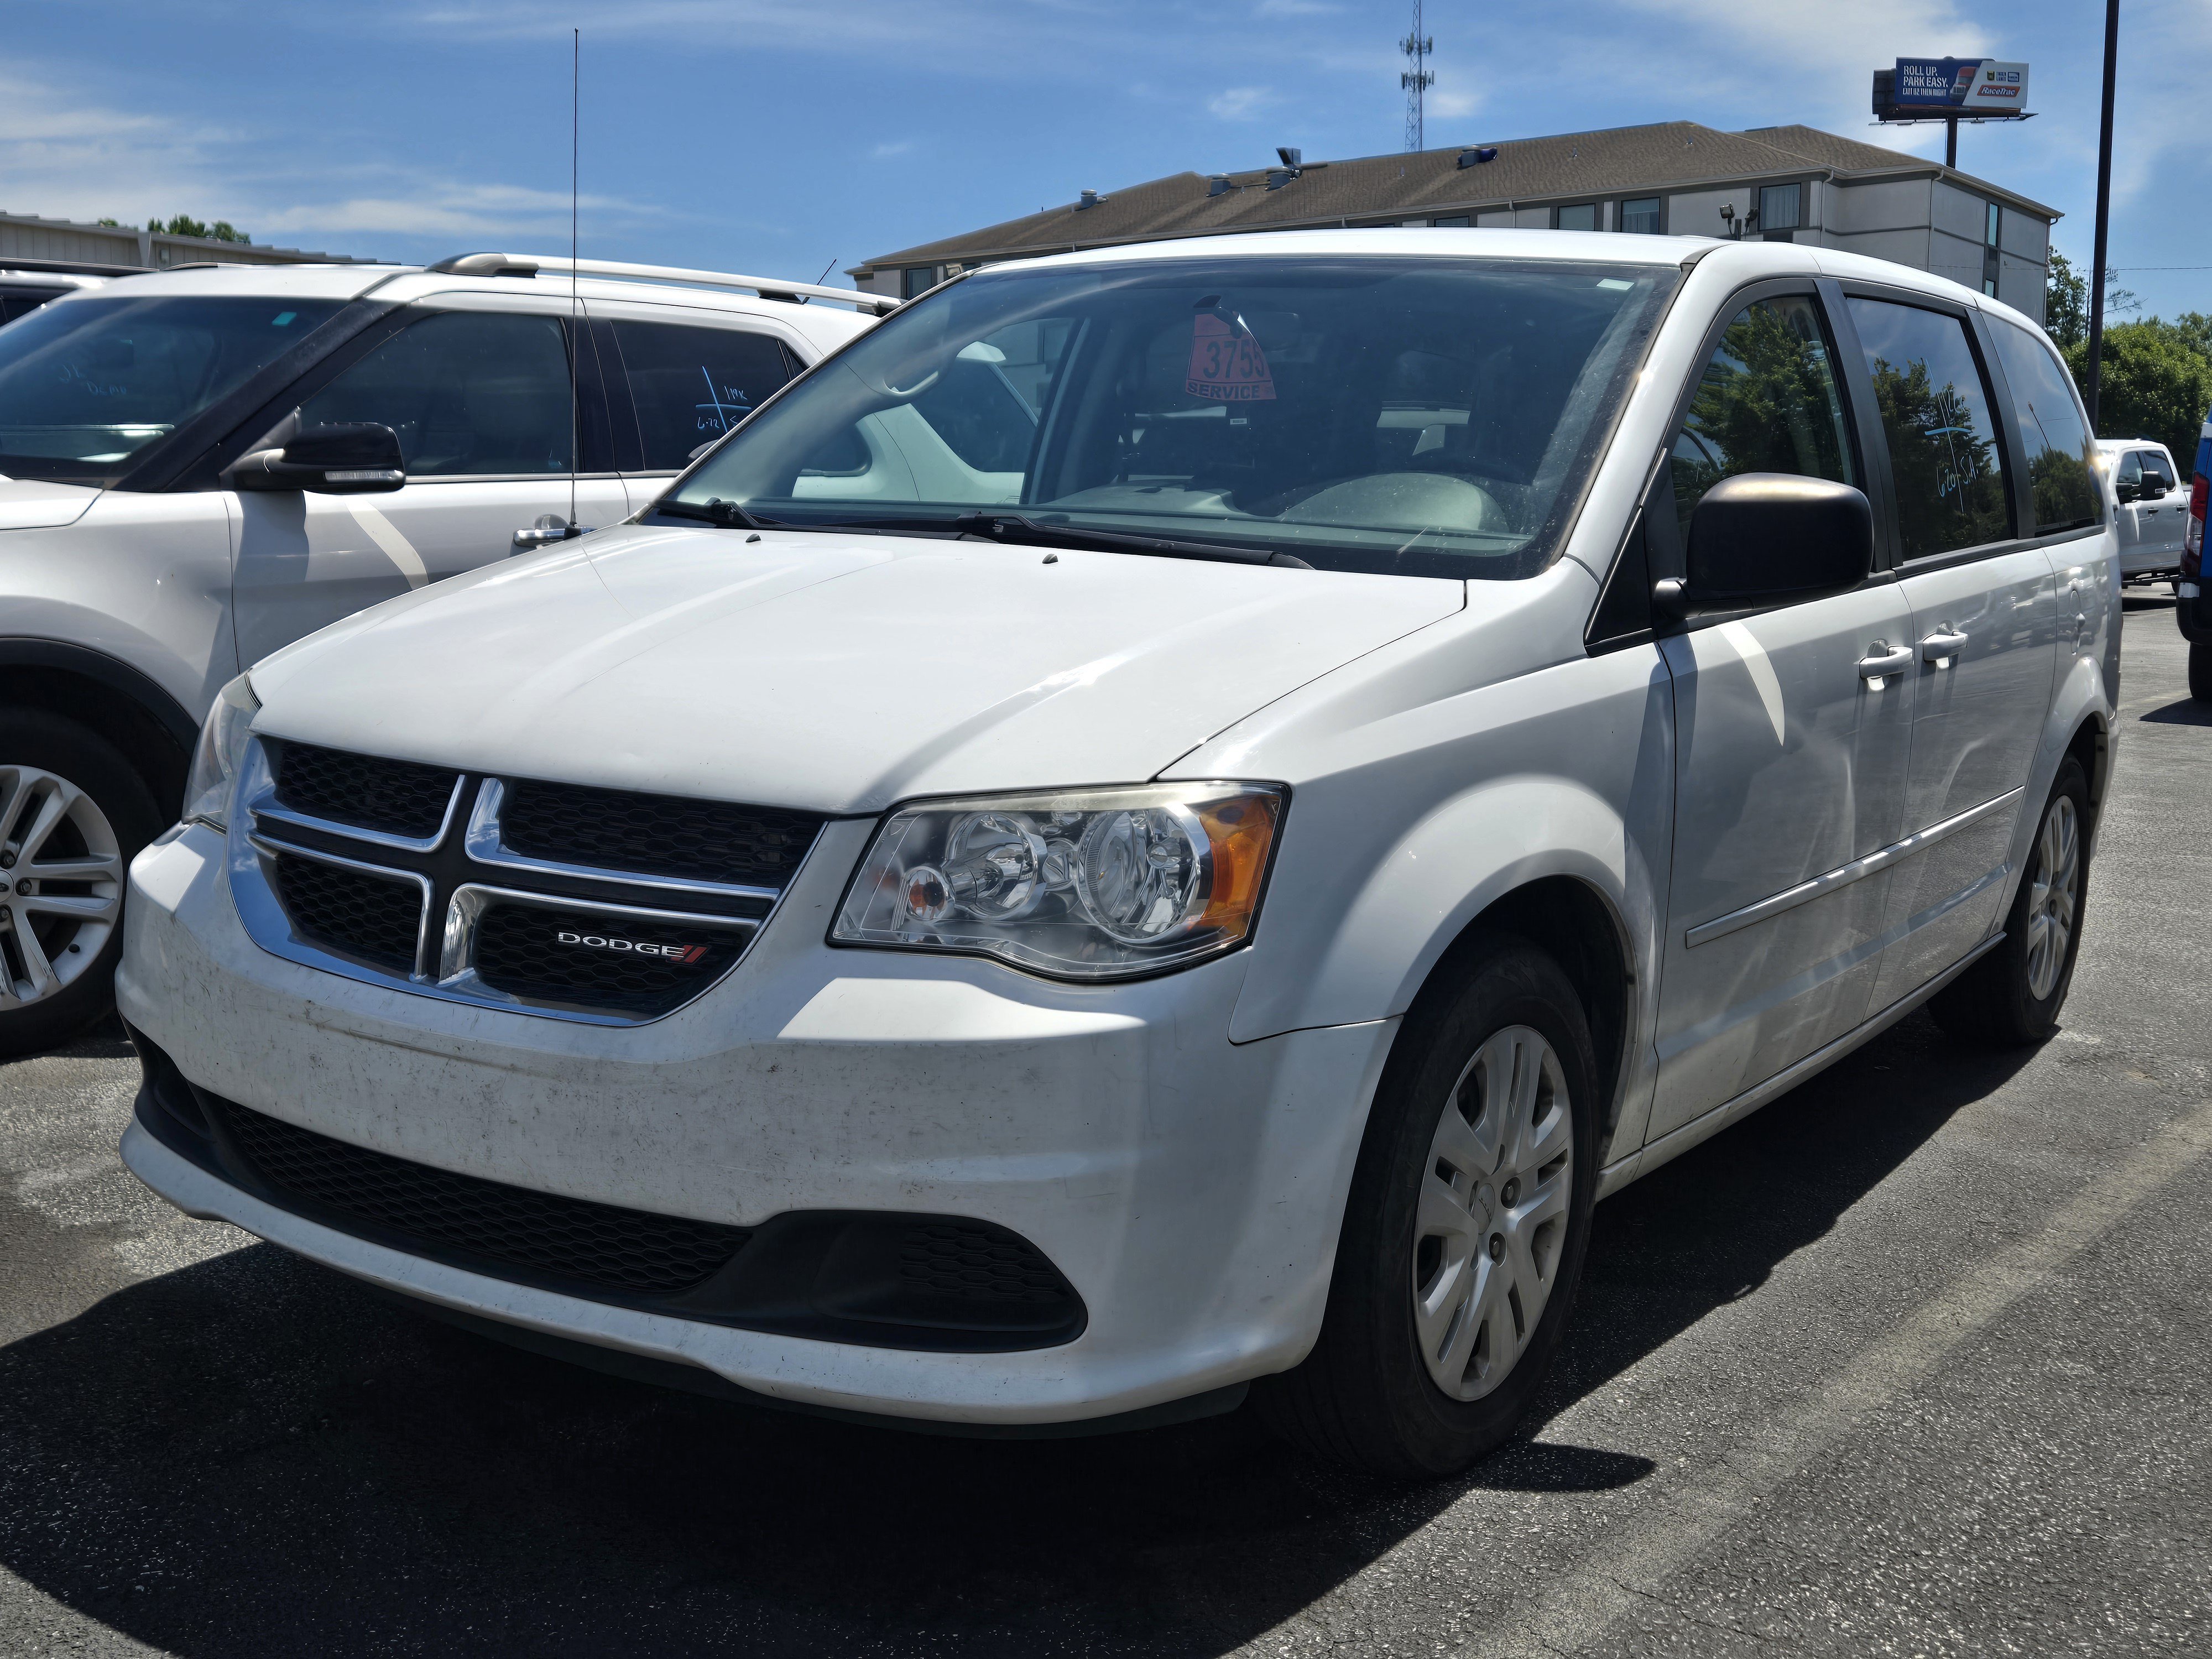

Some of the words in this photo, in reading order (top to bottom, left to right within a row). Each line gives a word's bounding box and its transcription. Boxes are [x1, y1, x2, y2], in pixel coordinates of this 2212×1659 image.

[1904, 65, 1924, 76] ROLL
[1926, 66, 1938, 76] UP.
[1903, 76, 1925, 87] PARK
[1926, 76, 1948, 87] EASY.
[1187, 382, 1260, 400] SERVICE
[558, 932, 685, 958] DODGE
